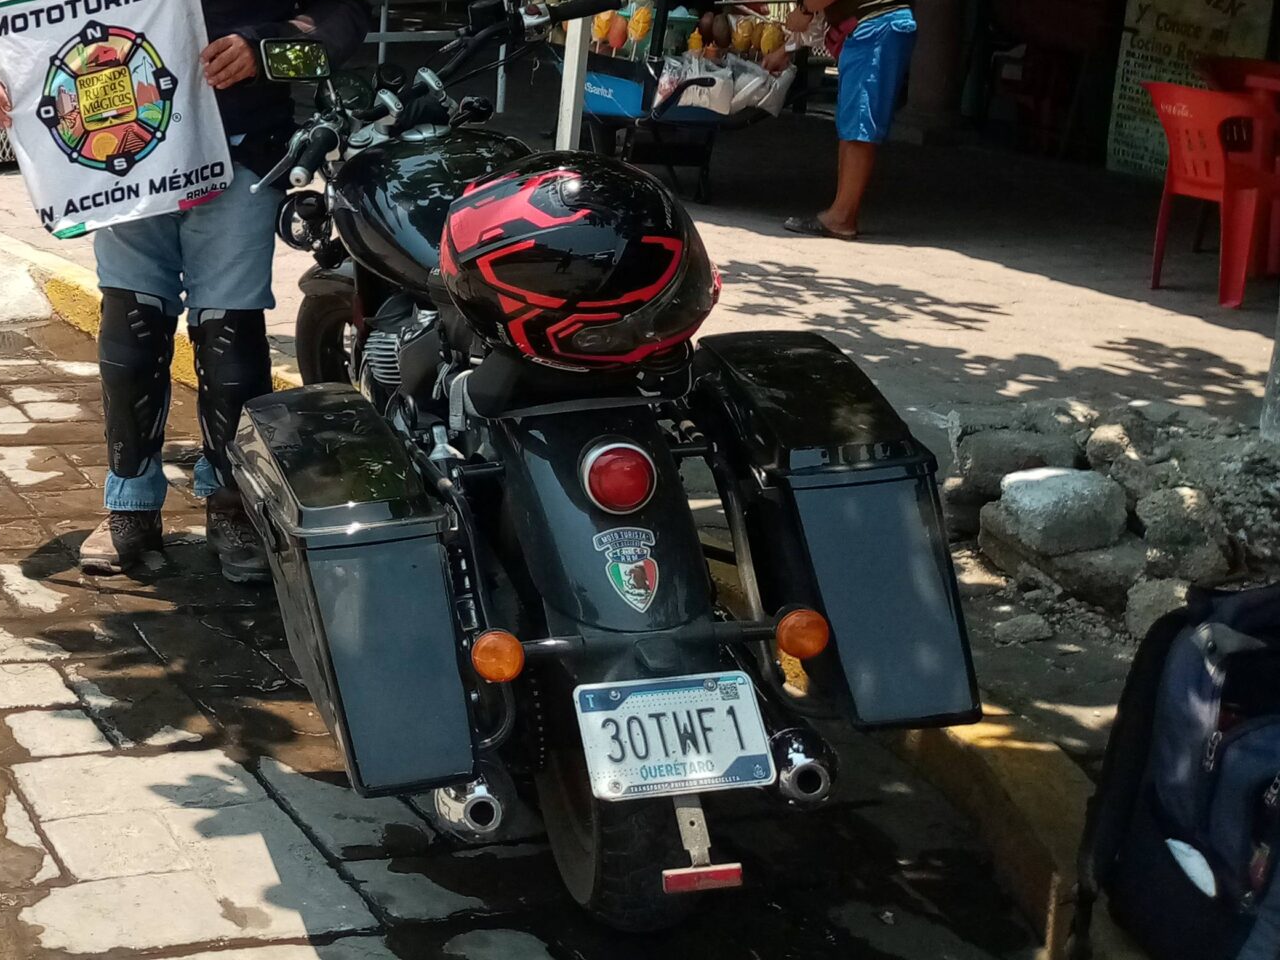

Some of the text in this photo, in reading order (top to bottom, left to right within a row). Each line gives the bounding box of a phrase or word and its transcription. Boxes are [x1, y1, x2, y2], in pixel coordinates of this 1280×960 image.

[86, 27, 102, 39] N
[159, 76, 173, 90] E
[40, 105, 55, 118] O
[113, 157, 127, 171] S
[64, 180, 140, 217] ACCIÓN
[149, 160, 226, 195] MÉXICO
[186, 187, 208, 201] RRM
[601, 530, 646, 543] MOTO TURISTA
[586, 694, 595, 708] T
[601, 705, 746, 763] 30TWF1
[640, 759, 715, 781] QUERÉTARO
